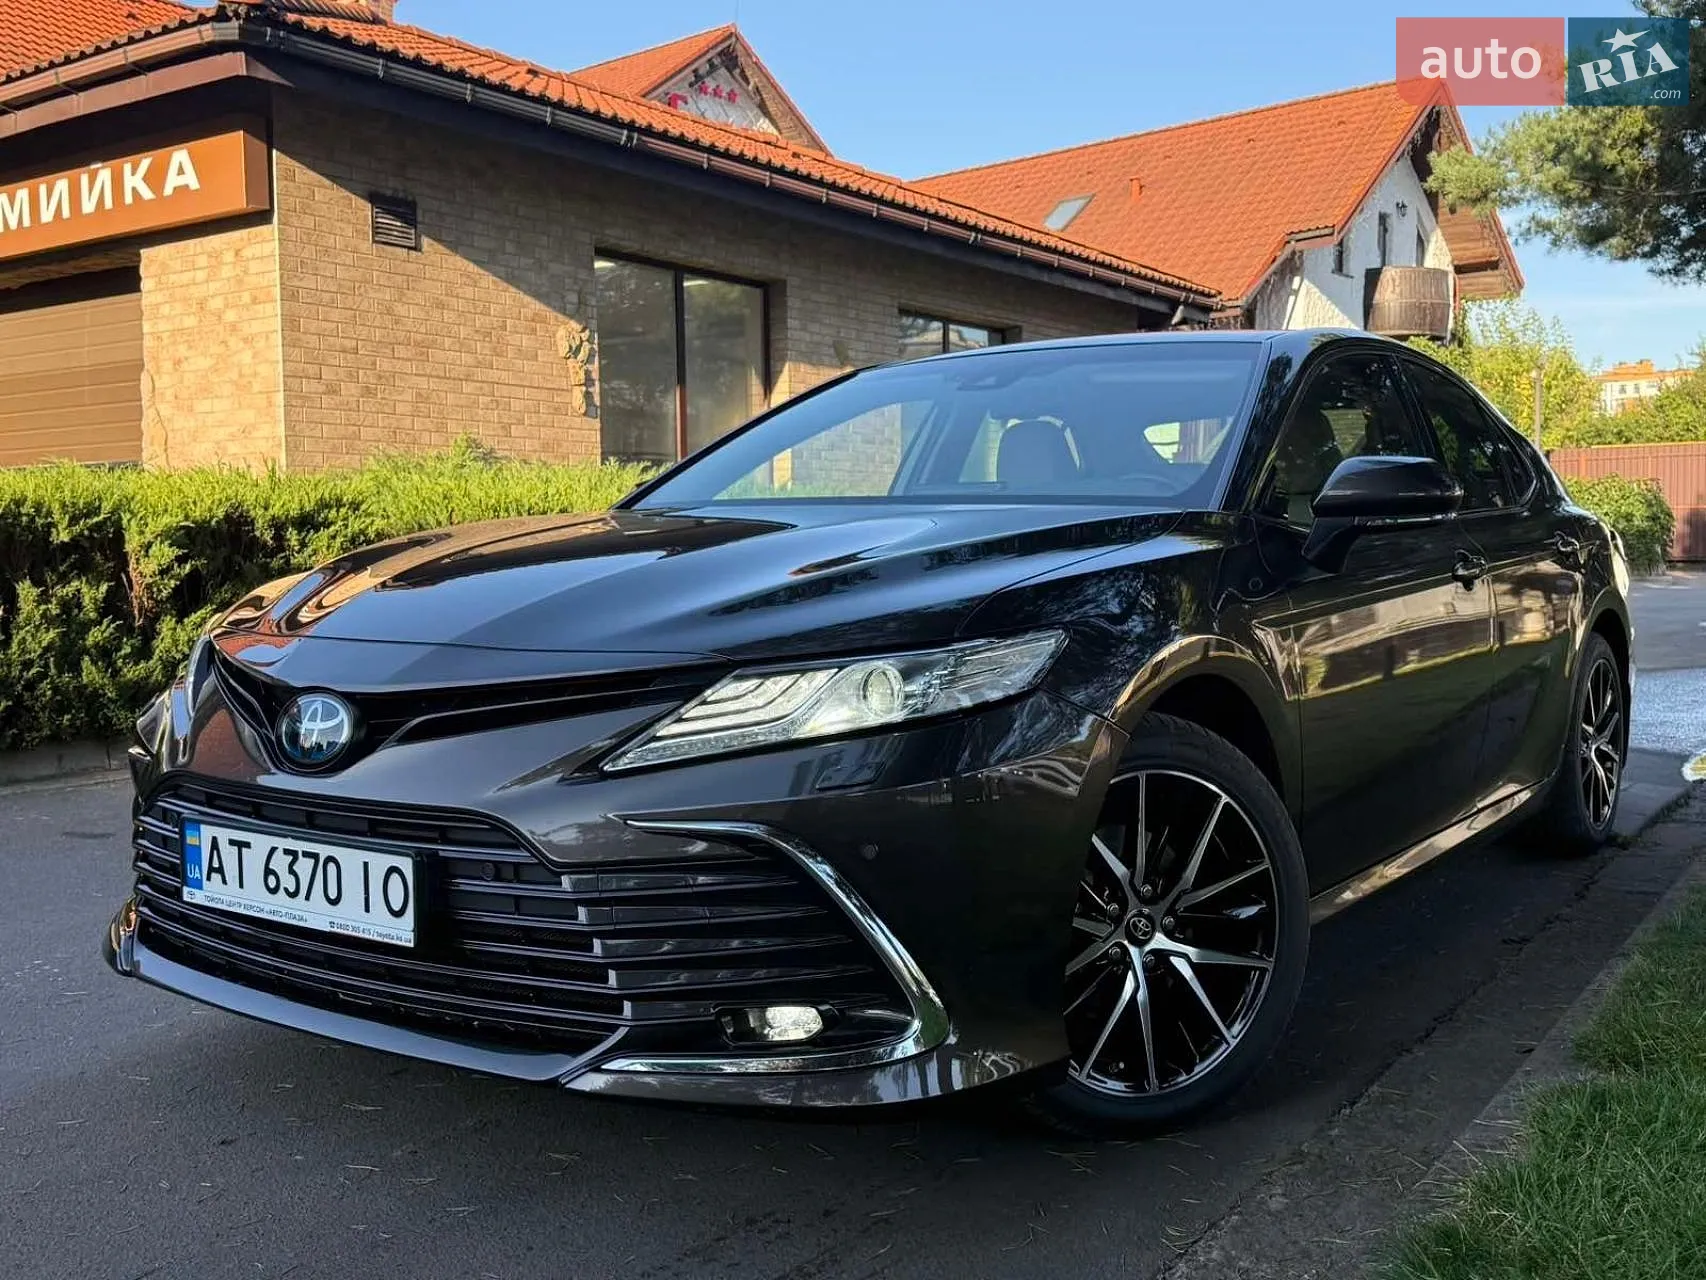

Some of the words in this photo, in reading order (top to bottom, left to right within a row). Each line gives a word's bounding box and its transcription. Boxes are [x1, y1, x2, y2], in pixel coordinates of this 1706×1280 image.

[0, 148, 200, 233] МИЙКА
[187, 864, 201, 880] UA
[206, 836, 251, 889] AT
[263, 846, 343, 906] 6370
[363, 861, 410, 919] IO
